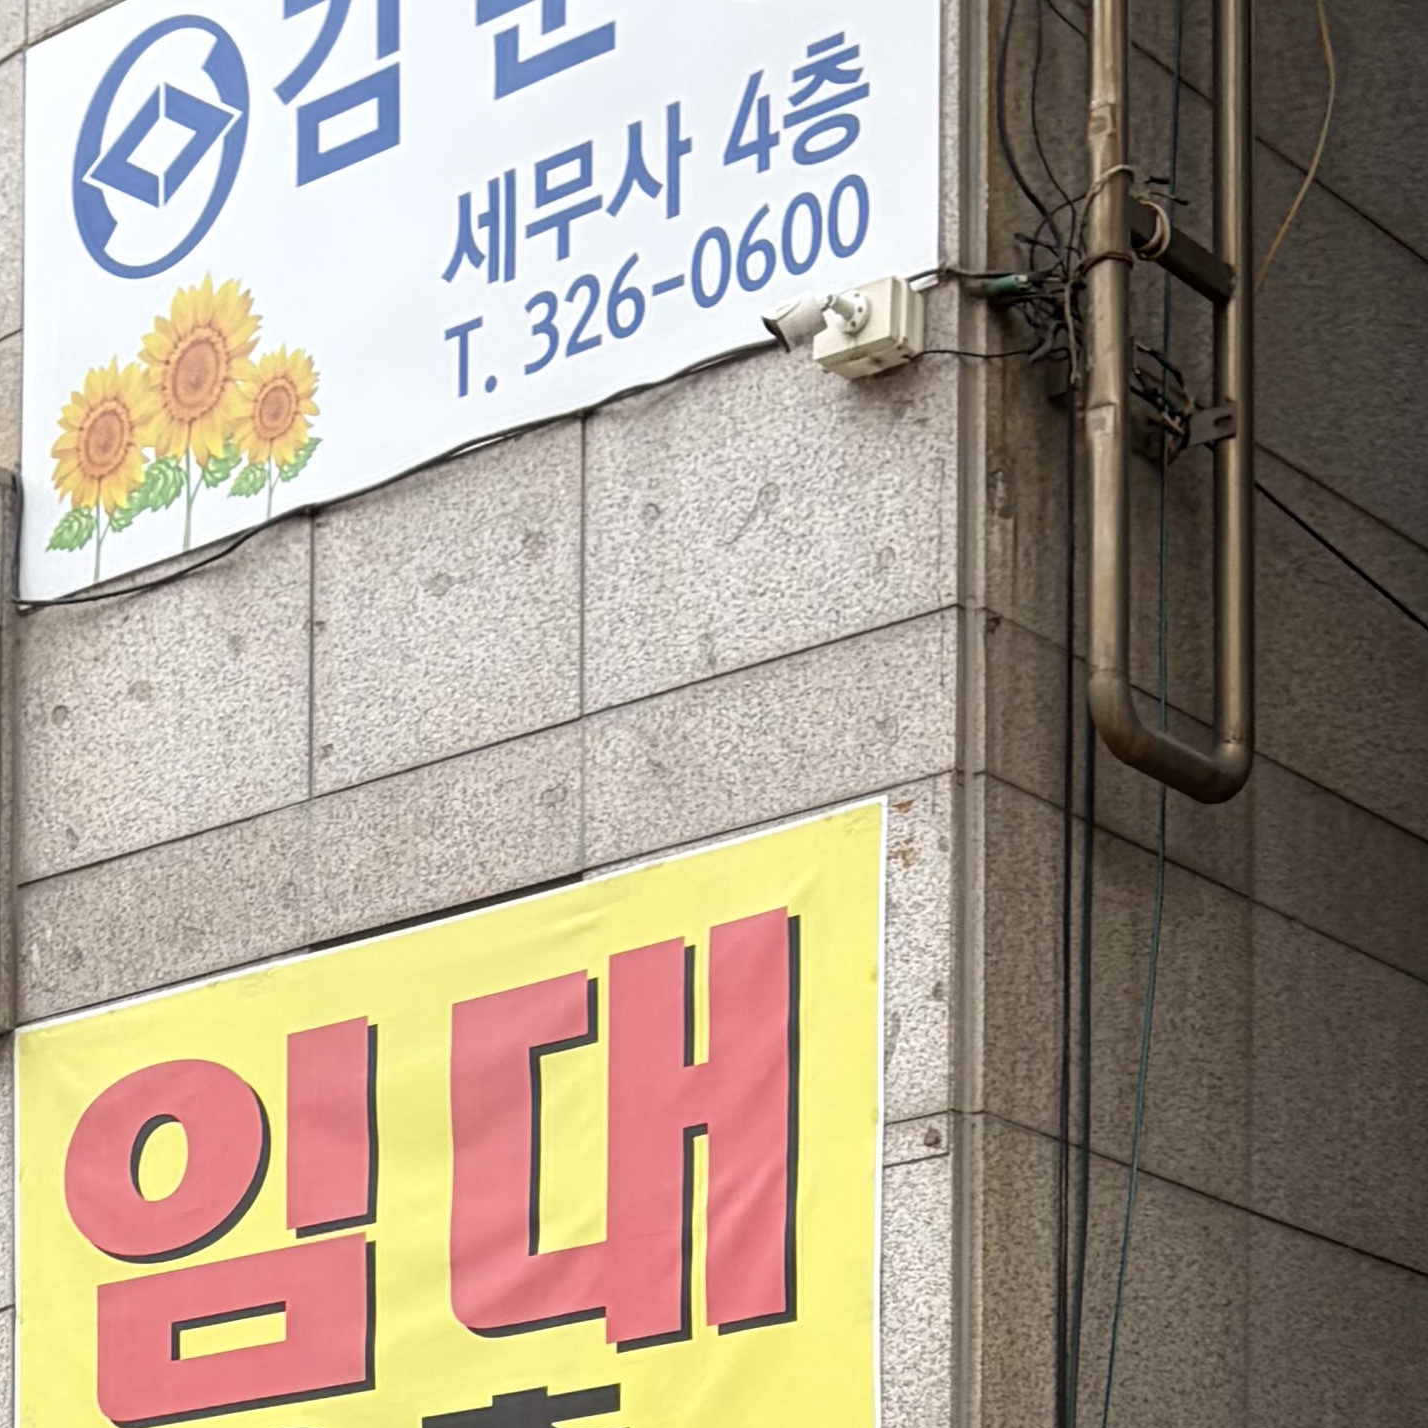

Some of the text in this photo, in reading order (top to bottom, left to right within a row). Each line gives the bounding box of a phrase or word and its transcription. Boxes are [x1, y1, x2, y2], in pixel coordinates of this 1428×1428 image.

[442, 31, 871, 286] 세무사 4층
[444, 173, 871, 399] T. 326-0600
